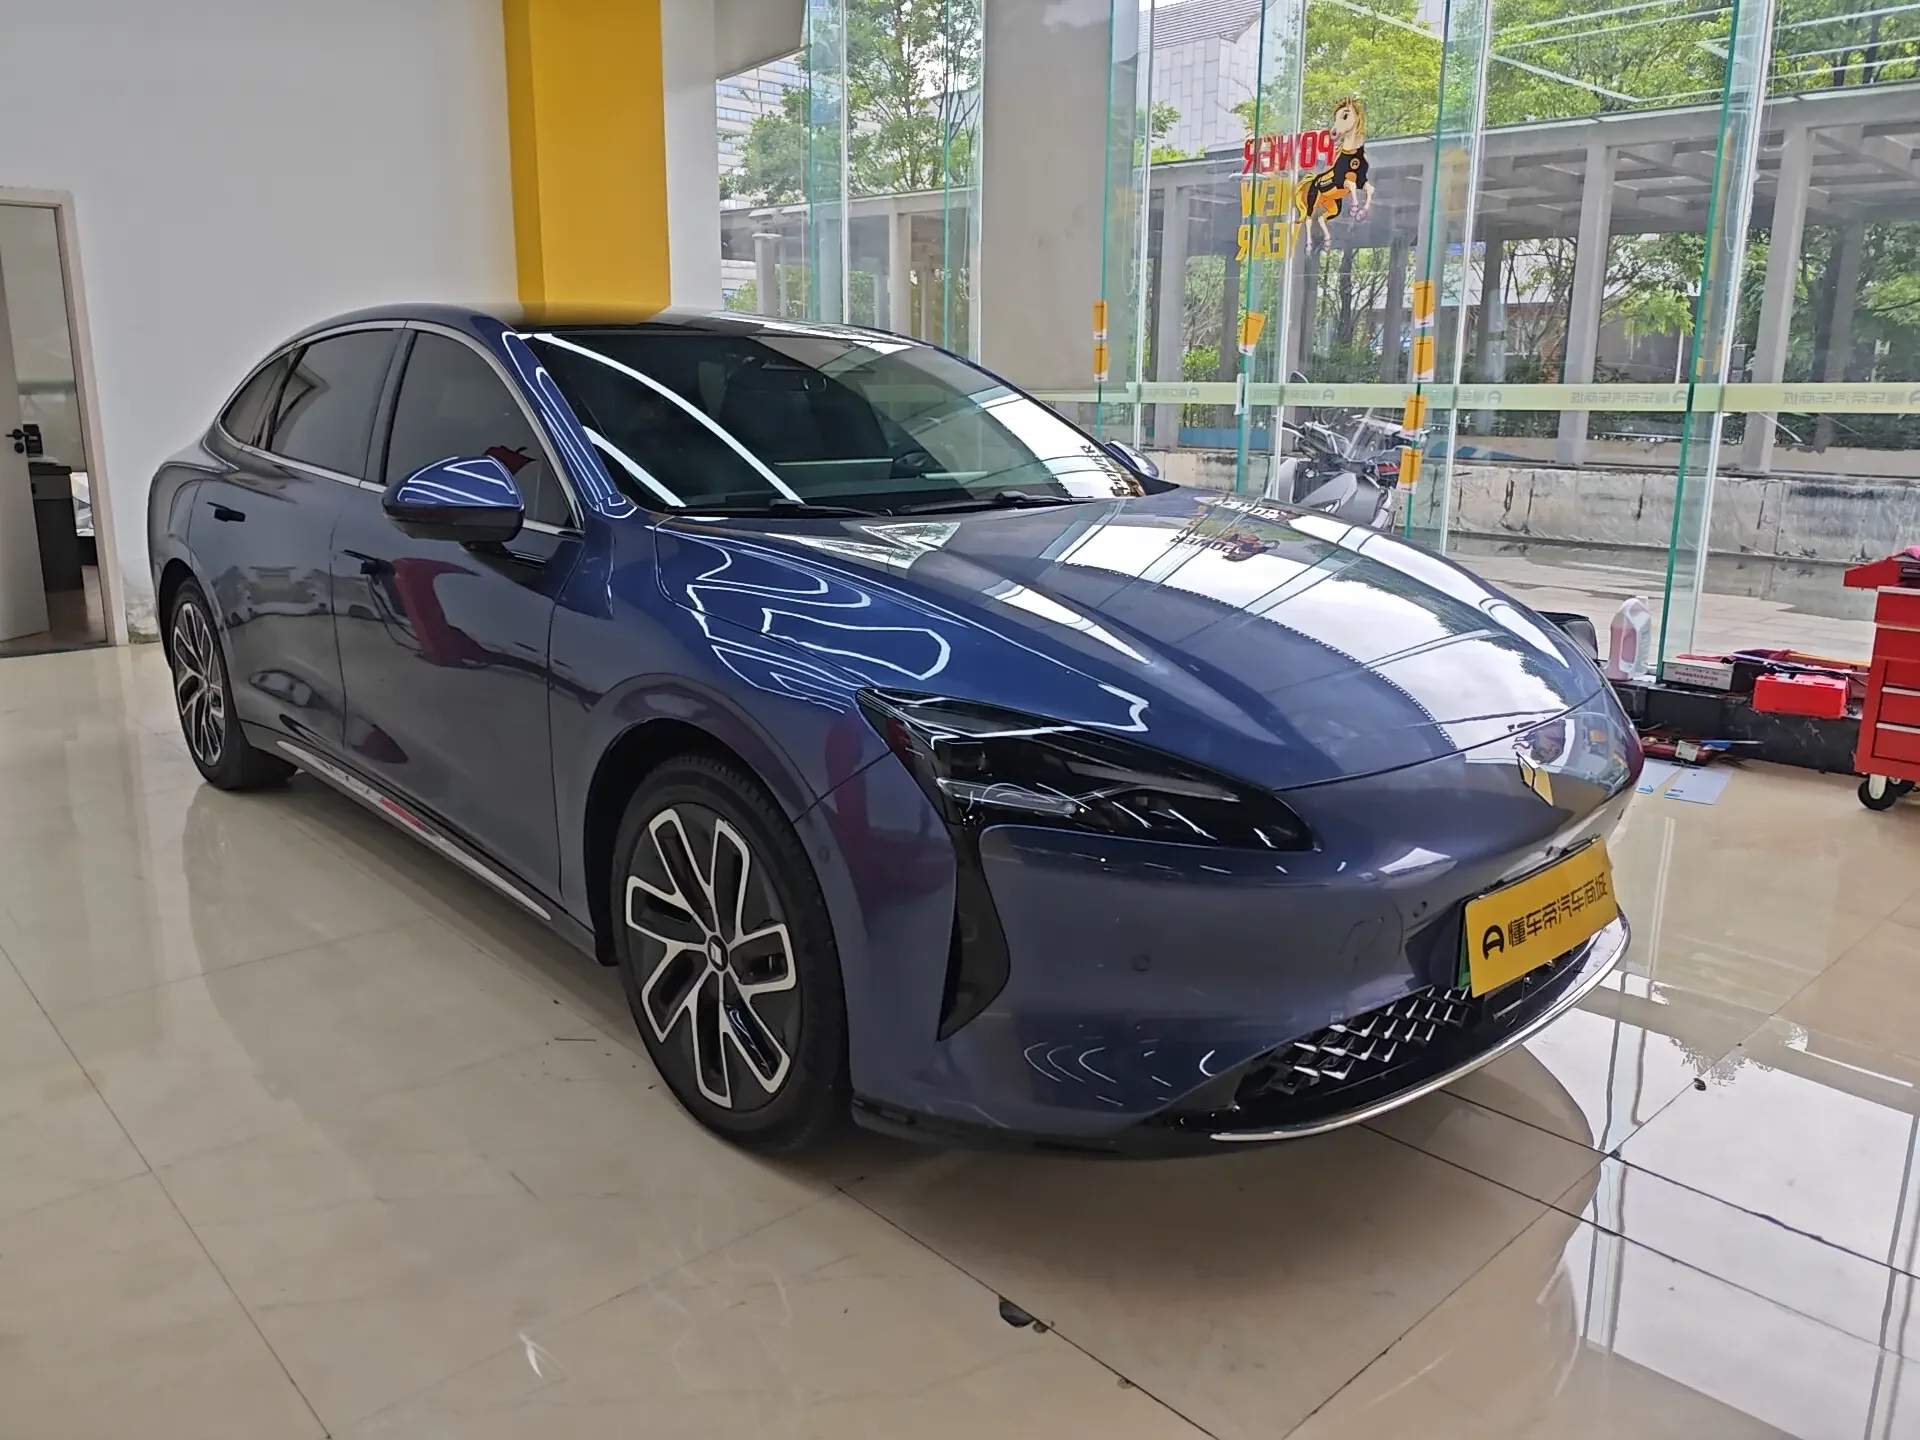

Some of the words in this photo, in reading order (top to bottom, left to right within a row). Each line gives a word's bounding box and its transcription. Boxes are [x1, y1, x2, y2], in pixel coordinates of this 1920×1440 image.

[1507, 872, 1608, 947] 懂车帝汽车商城
